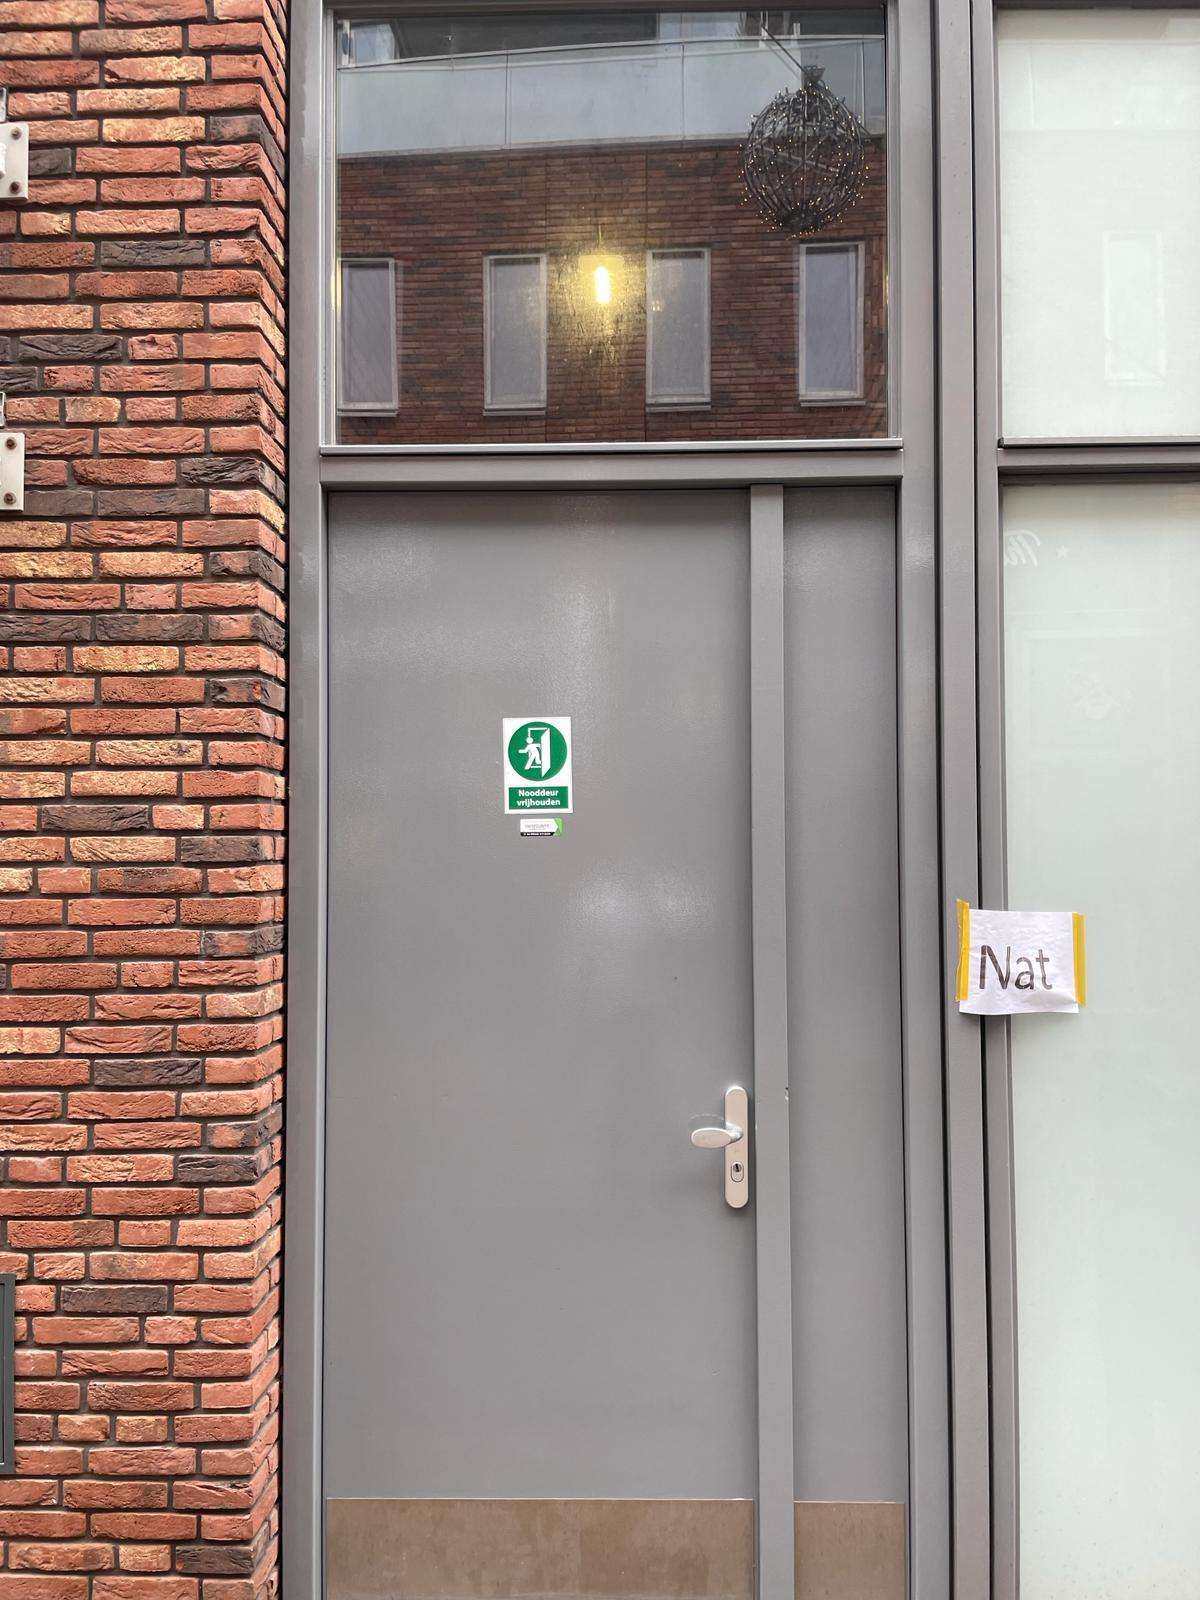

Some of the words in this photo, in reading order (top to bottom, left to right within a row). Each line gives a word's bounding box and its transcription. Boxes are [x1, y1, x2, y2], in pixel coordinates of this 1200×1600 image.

[518, 789, 559, 797] Nooddeur
[516, 798, 561, 807] vrijhouden
[979, 944, 1053, 990] Nat
